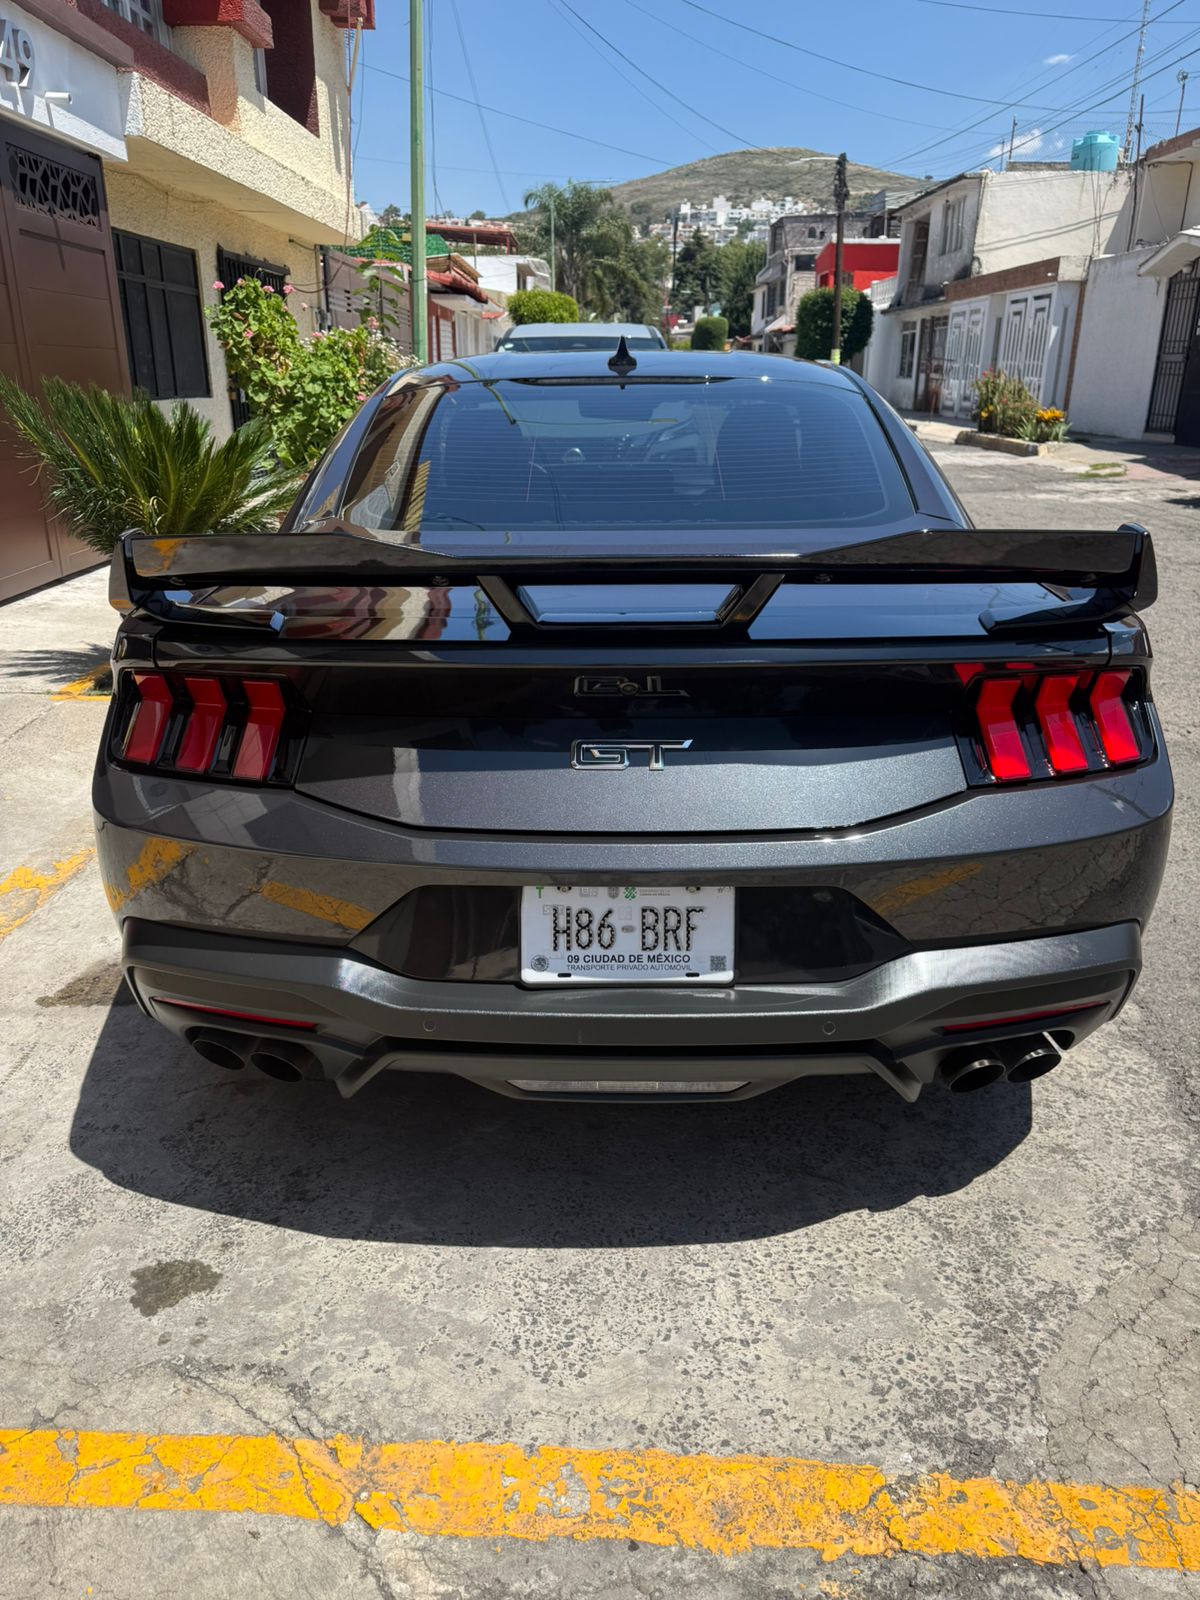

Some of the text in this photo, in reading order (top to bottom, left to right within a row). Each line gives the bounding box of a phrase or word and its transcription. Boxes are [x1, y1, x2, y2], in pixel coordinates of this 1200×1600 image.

[571, 739, 694, 771] GT
[567, 953, 691, 964] 09 CIUDAD DE MÉXICO
